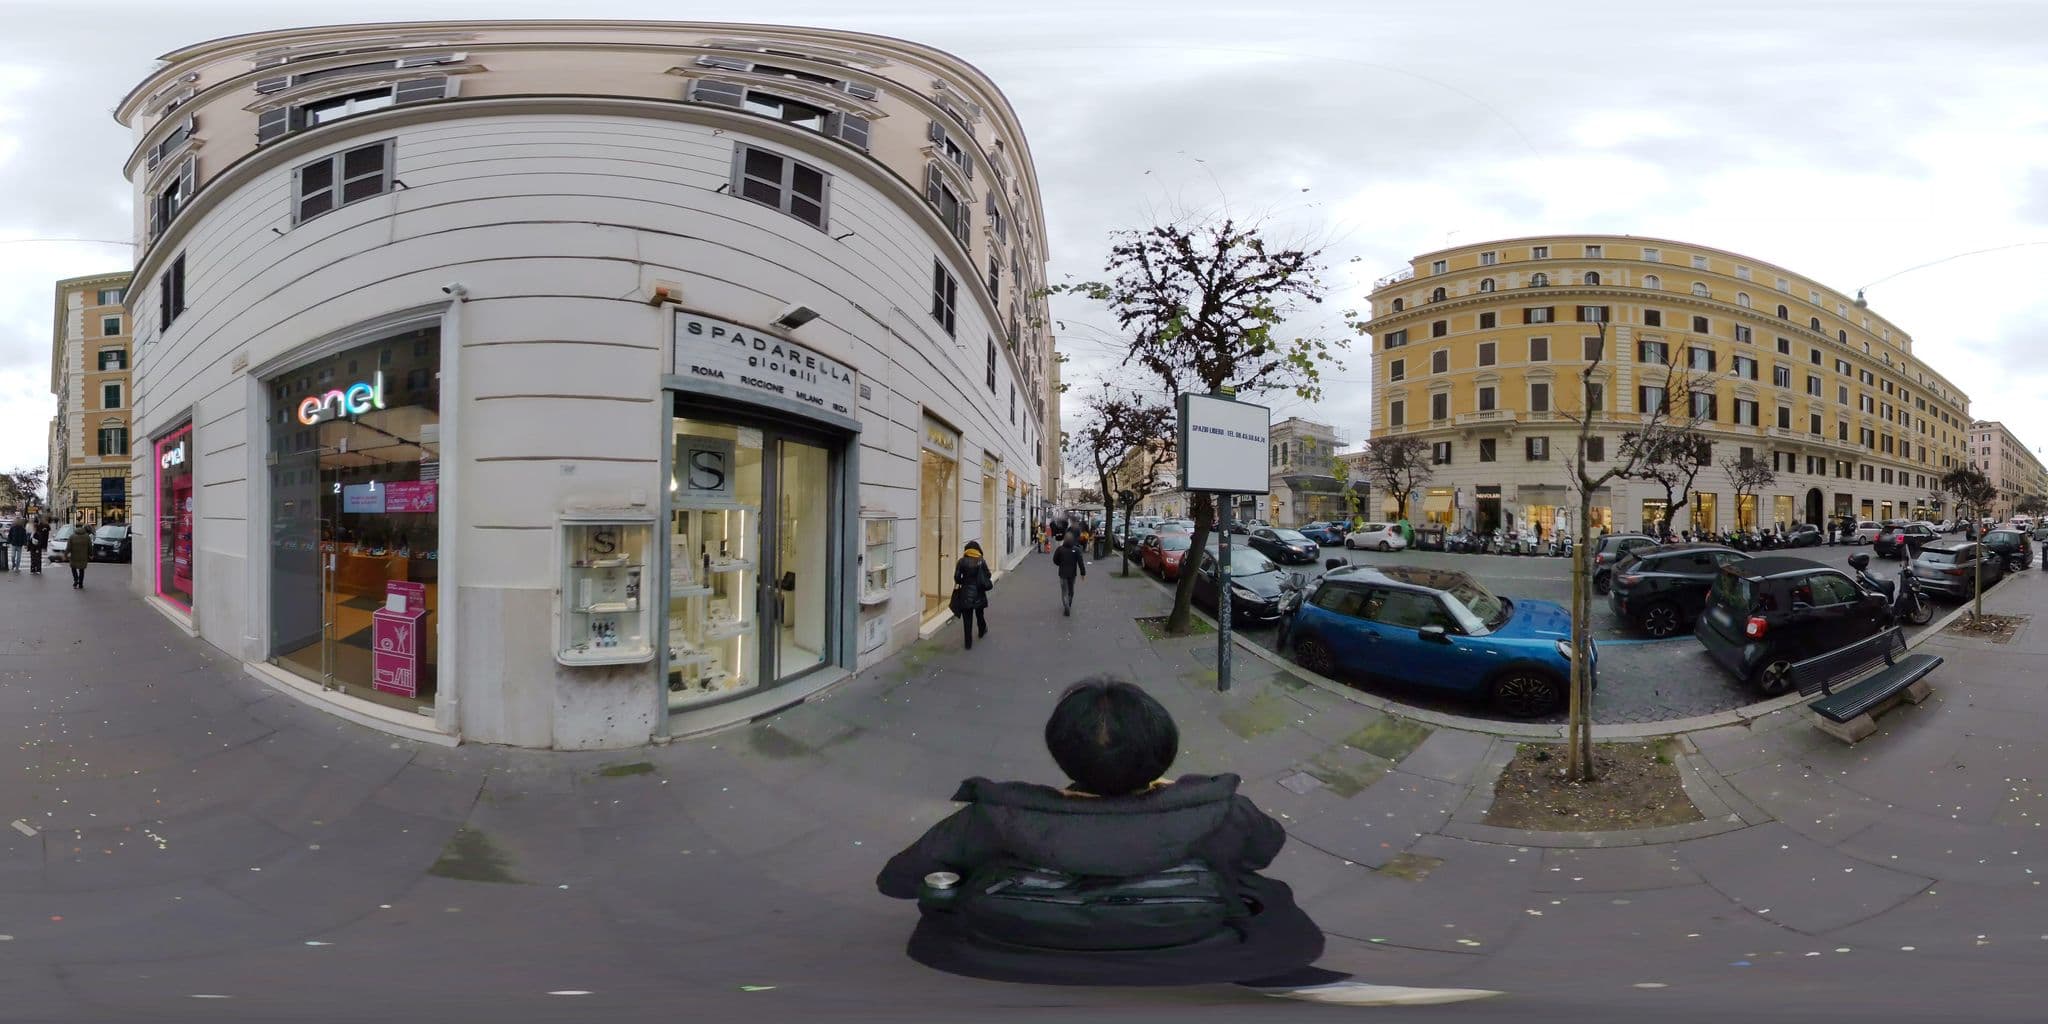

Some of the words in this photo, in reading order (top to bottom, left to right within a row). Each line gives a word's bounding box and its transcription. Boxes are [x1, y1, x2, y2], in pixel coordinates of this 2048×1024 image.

[687, 321, 851, 385] SPADARELLA
[748, 356, 817, 385] gioielli
[298, 370, 386, 425] enel
[691, 365, 725, 380] ROMA
[740, 375, 785, 395] RICCIONE
[796, 390, 824, 407] MILANO
[832, 402, 848, 415] IBIZA
[161, 440, 185, 470] enel
[690, 450, 725, 490] S
[333, 482, 341, 494] 2
[368, 480, 376, 492] 1
